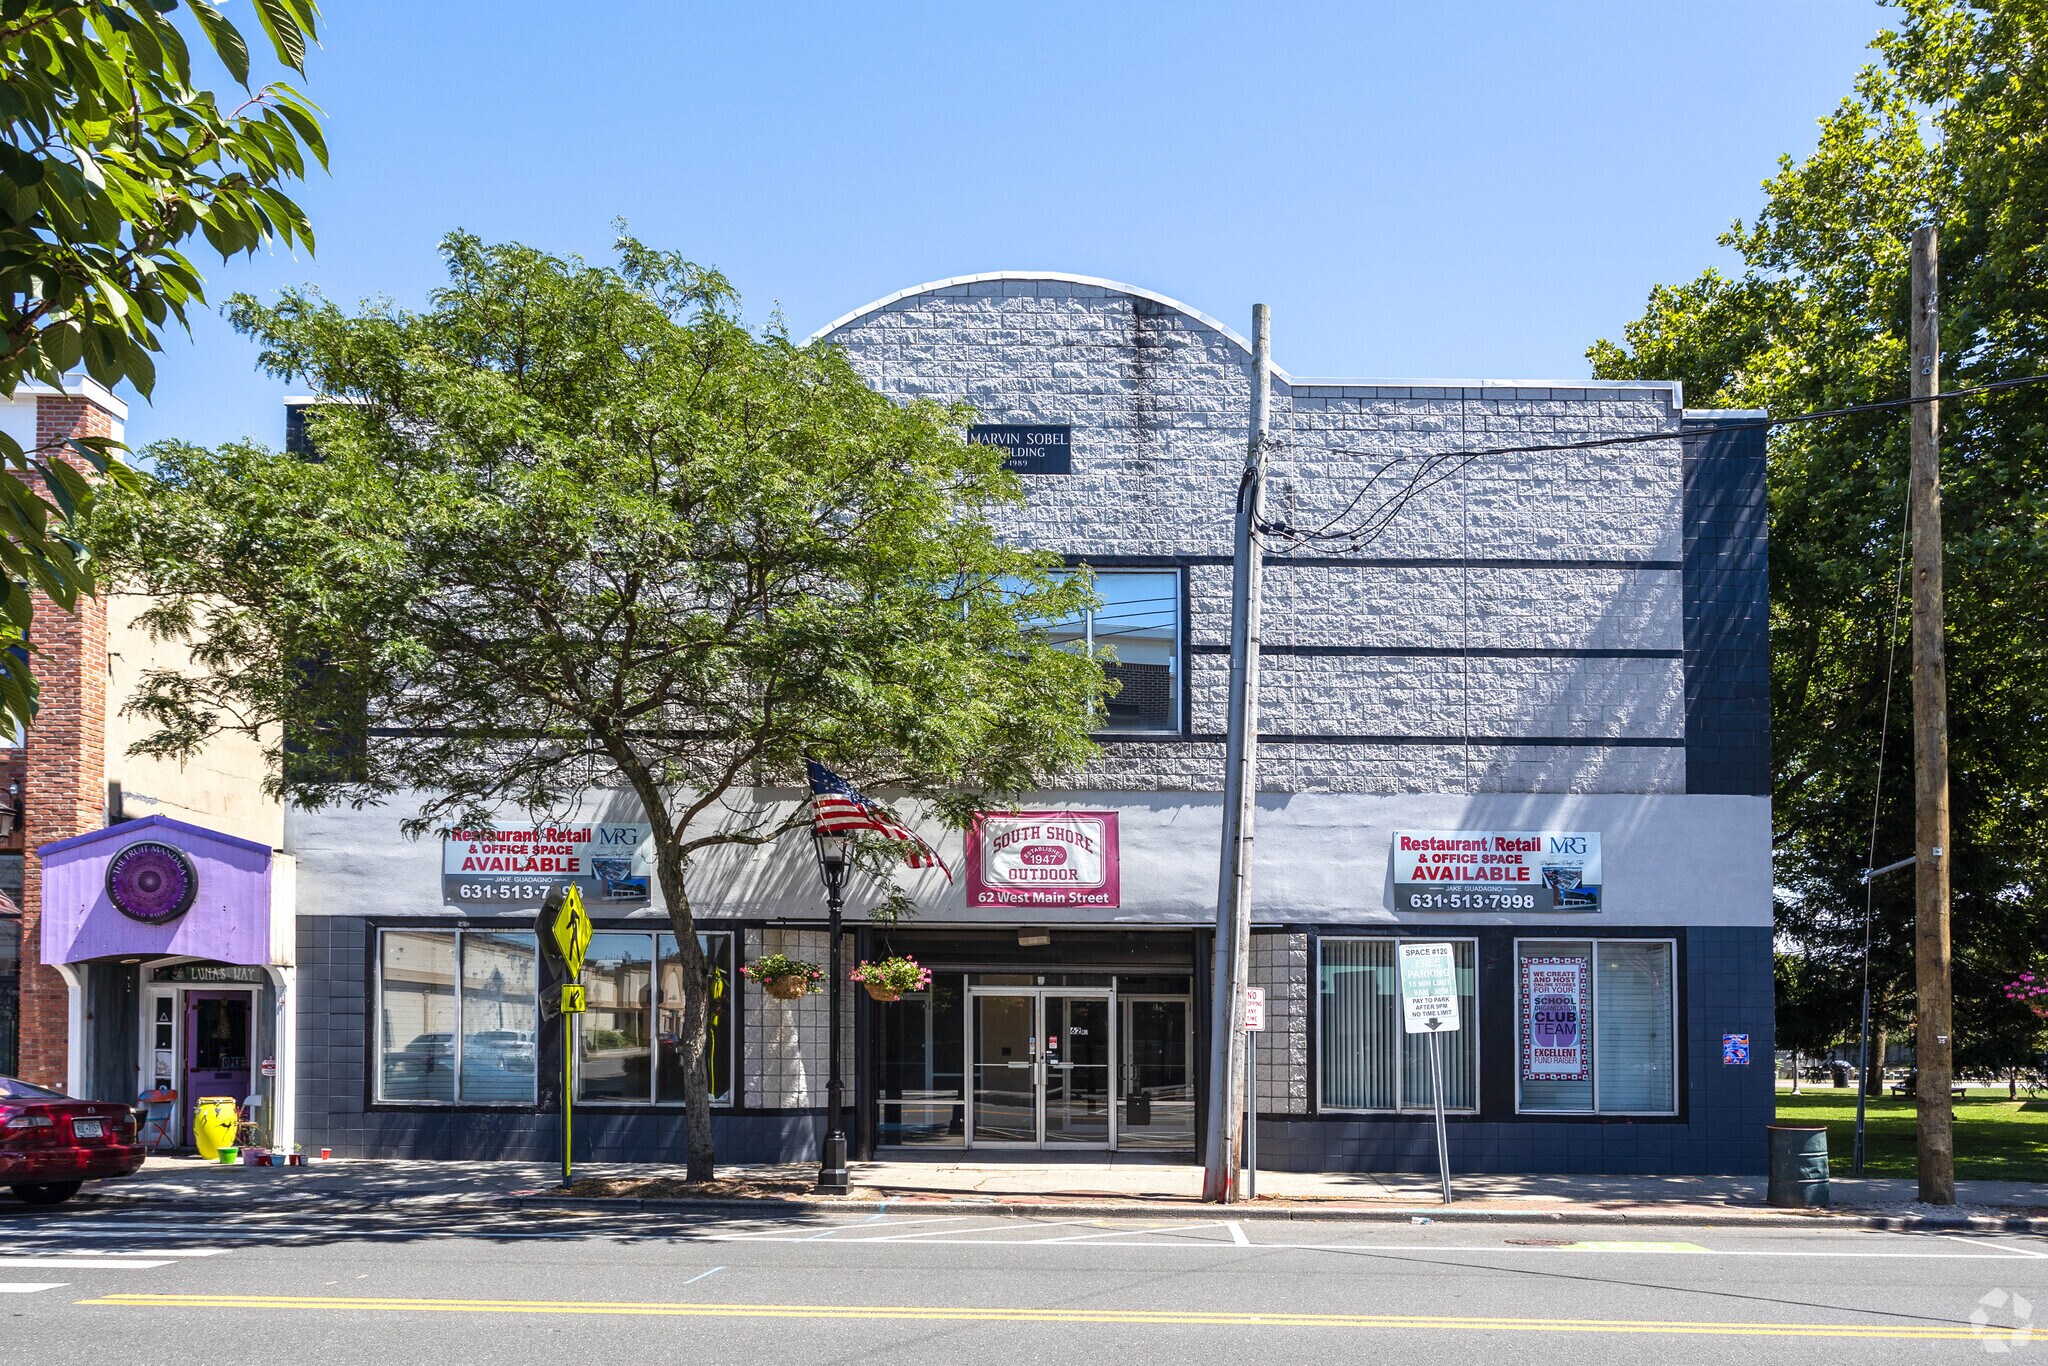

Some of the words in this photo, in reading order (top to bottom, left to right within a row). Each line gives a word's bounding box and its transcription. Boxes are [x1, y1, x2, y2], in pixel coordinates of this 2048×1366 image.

[970, 433, 1020, 444] MARVIN
[1026, 433, 1068, 445] SOBEL
[600, 828, 638, 846] MRG
[994, 826, 1040, 854] SOUTH
[1047, 826, 1094, 854] SHORE
[468, 844, 478, 854] &
[482, 844, 528, 855] OFFICE
[532, 845, 573, 856] SPACE
[1550, 836, 1587, 854] MRG
[1024, 846, 1064, 858] ESTABLISHED
[113, 859, 126, 874] THE
[124, 846, 148, 860] FRUIT
[150, 846, 187, 876] MANDALA
[461, 857, 580, 872] AVAILABLE
[1030, 854, 1056, 864] 1947
[1418, 854, 1428, 863] &
[1432, 854, 1478, 864] OFFICE
[1481, 854, 1522, 864] SPACE
[1008, 868, 1078, 880] OUTDOOR
[1412, 866, 1530, 881] AVAILABLE
[978, 892, 994, 903] 62
[997, 892, 1029, 903] West
[1032, 891, 1066, 903] Main
[1068, 892, 1109, 903] Street
[1416, 959, 1440, 968] FREE
[233, 968, 255, 980] WAY
[1408, 968, 1450, 978] PARKING
[1248, 992, 1256, 1000] NO
[1534, 1012, 1576, 1022] CLUB
[1535, 1023, 1576, 1034] TEAM
[1534, 1048, 1577, 1056] EXCELLENT
